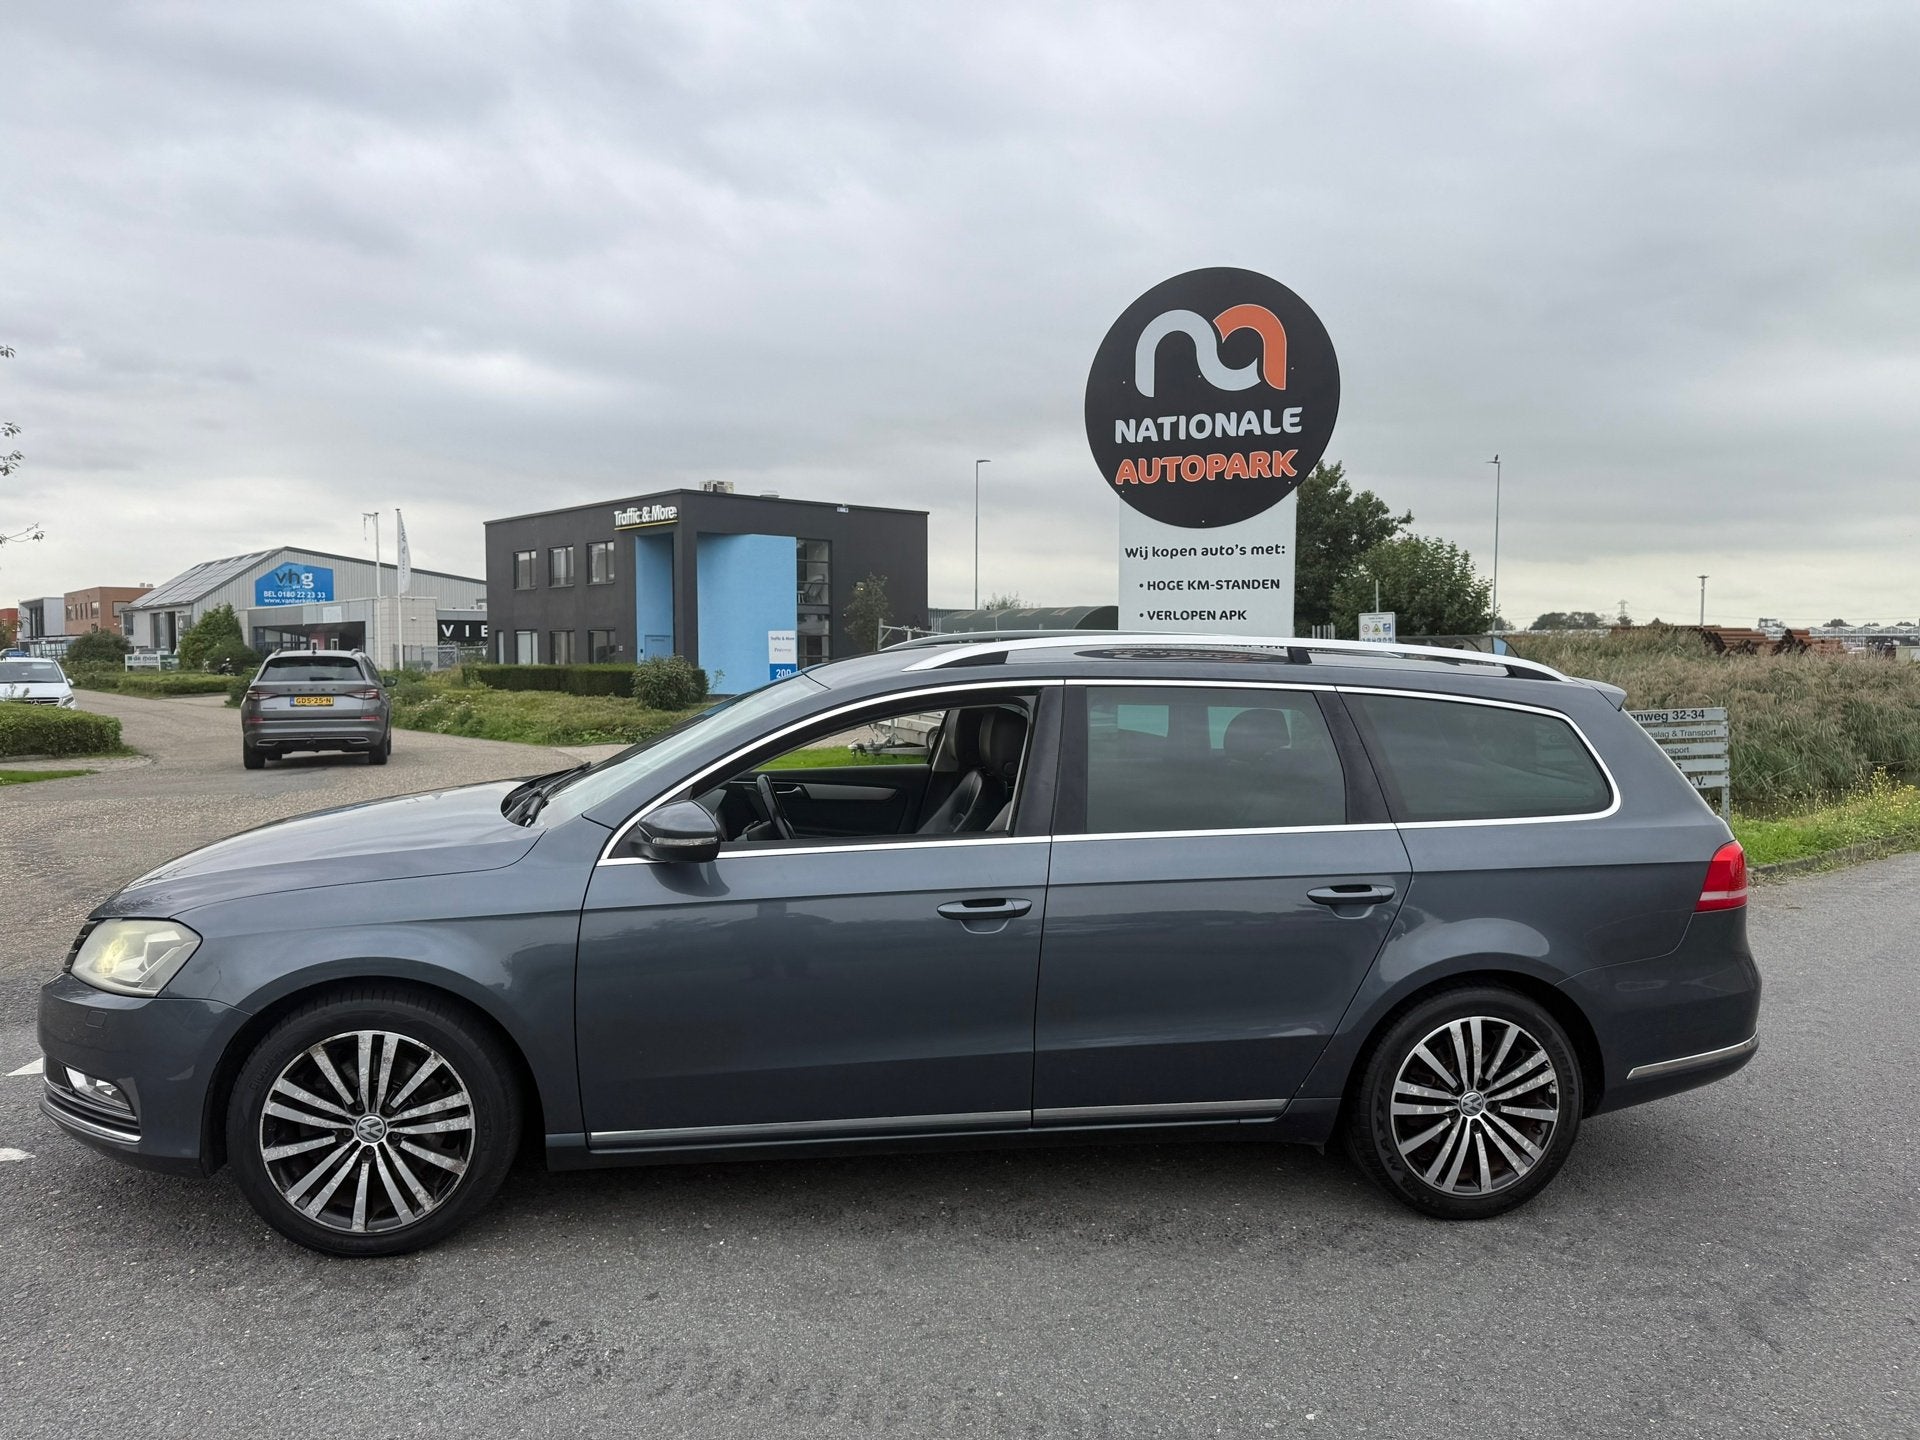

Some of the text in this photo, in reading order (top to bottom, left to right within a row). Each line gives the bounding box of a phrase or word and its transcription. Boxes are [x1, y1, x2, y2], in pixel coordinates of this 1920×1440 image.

[1115, 406, 1303, 444] NATIONALE
[1115, 449, 1299, 485] AUTOPARK
[614, 504, 678, 526] Traffic & More
[1125, 543, 1286, 560] Wij kopen auto's met:
[275, 568, 314, 589] vhg
[1147, 579, 1280, 591] HOGE KM-STANDEN
[263, 590, 278, 598] BEL
[277, 590, 296, 598] 0180
[317, 591, 326, 599] 33
[1147, 610, 1248, 621] VERLOPEN APK
[776, 668, 792, 678] 200
[1672, 709, 1705, 720] 32-34
[1680, 729, 1717, 738] Transport
